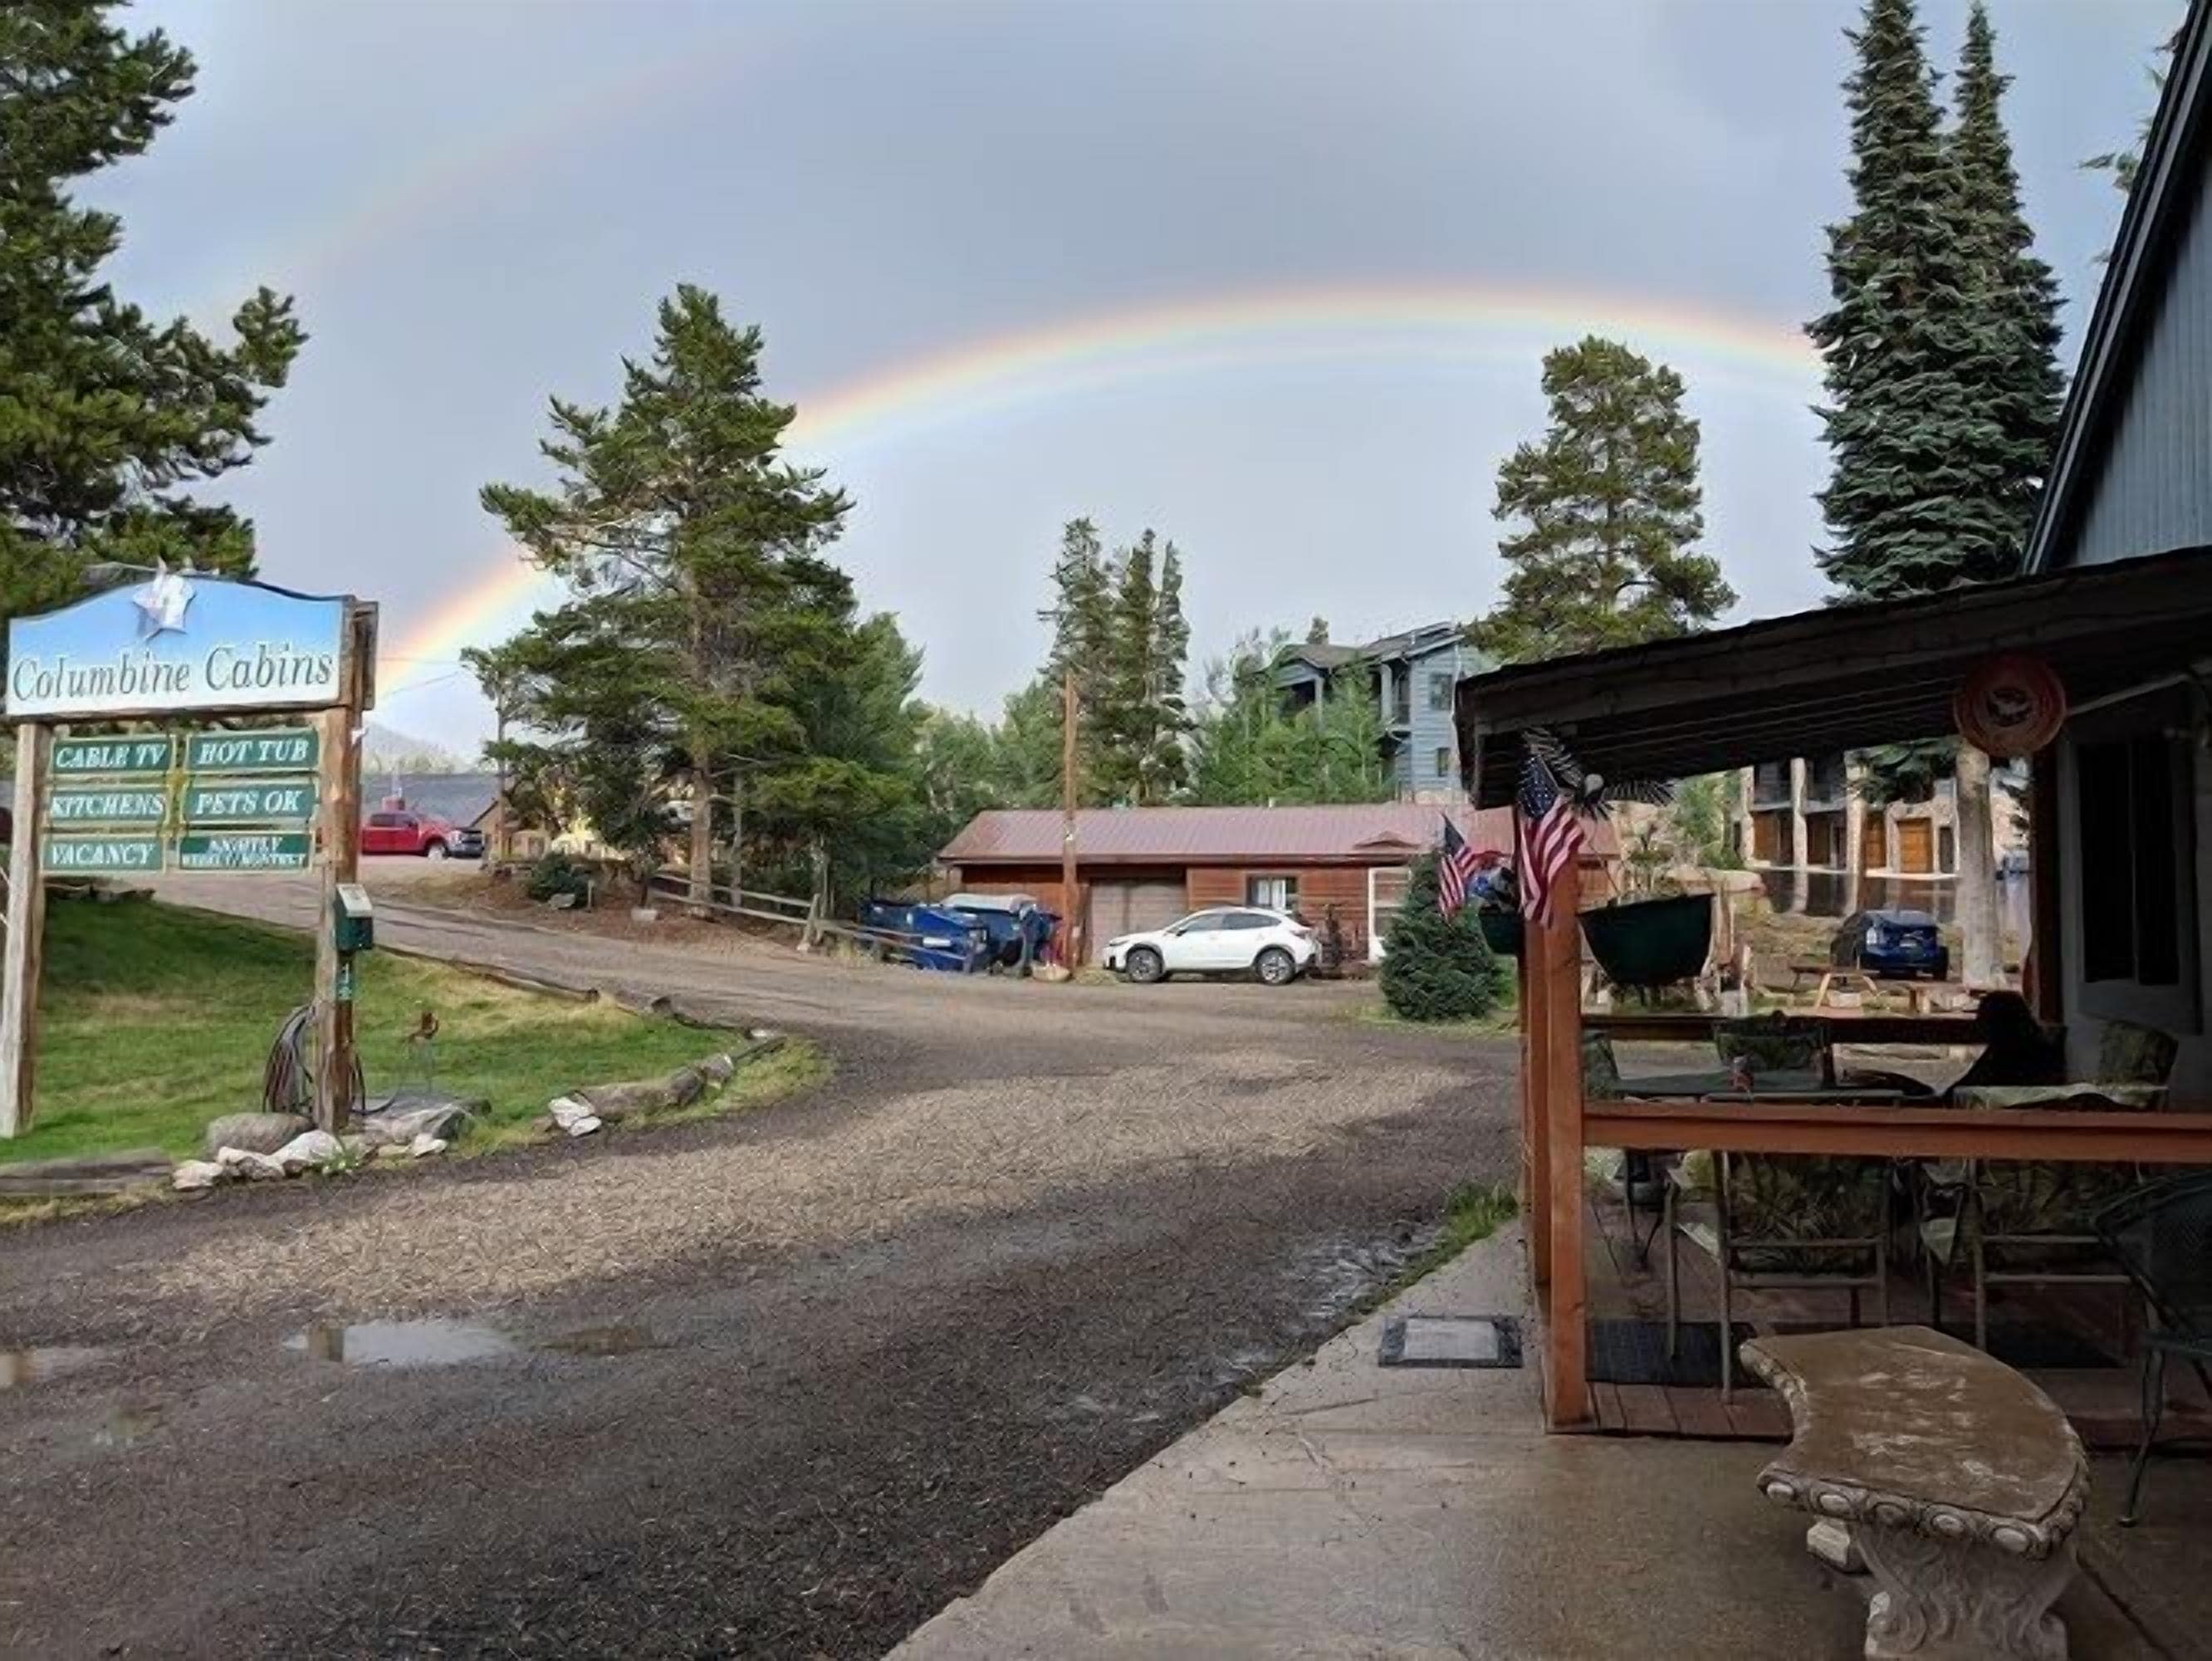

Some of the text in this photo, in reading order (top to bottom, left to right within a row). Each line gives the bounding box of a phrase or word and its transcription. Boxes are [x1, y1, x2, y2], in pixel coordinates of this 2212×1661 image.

[12, 642, 334, 702] Columbine Cabins
[56, 743, 167, 768] CABLE TV
[198, 737, 309, 765] HOT TUB
[51, 793, 166, 818] KITCHENS
[196, 790, 302, 816] PETS OK
[52, 843, 156, 865] VACANCY
